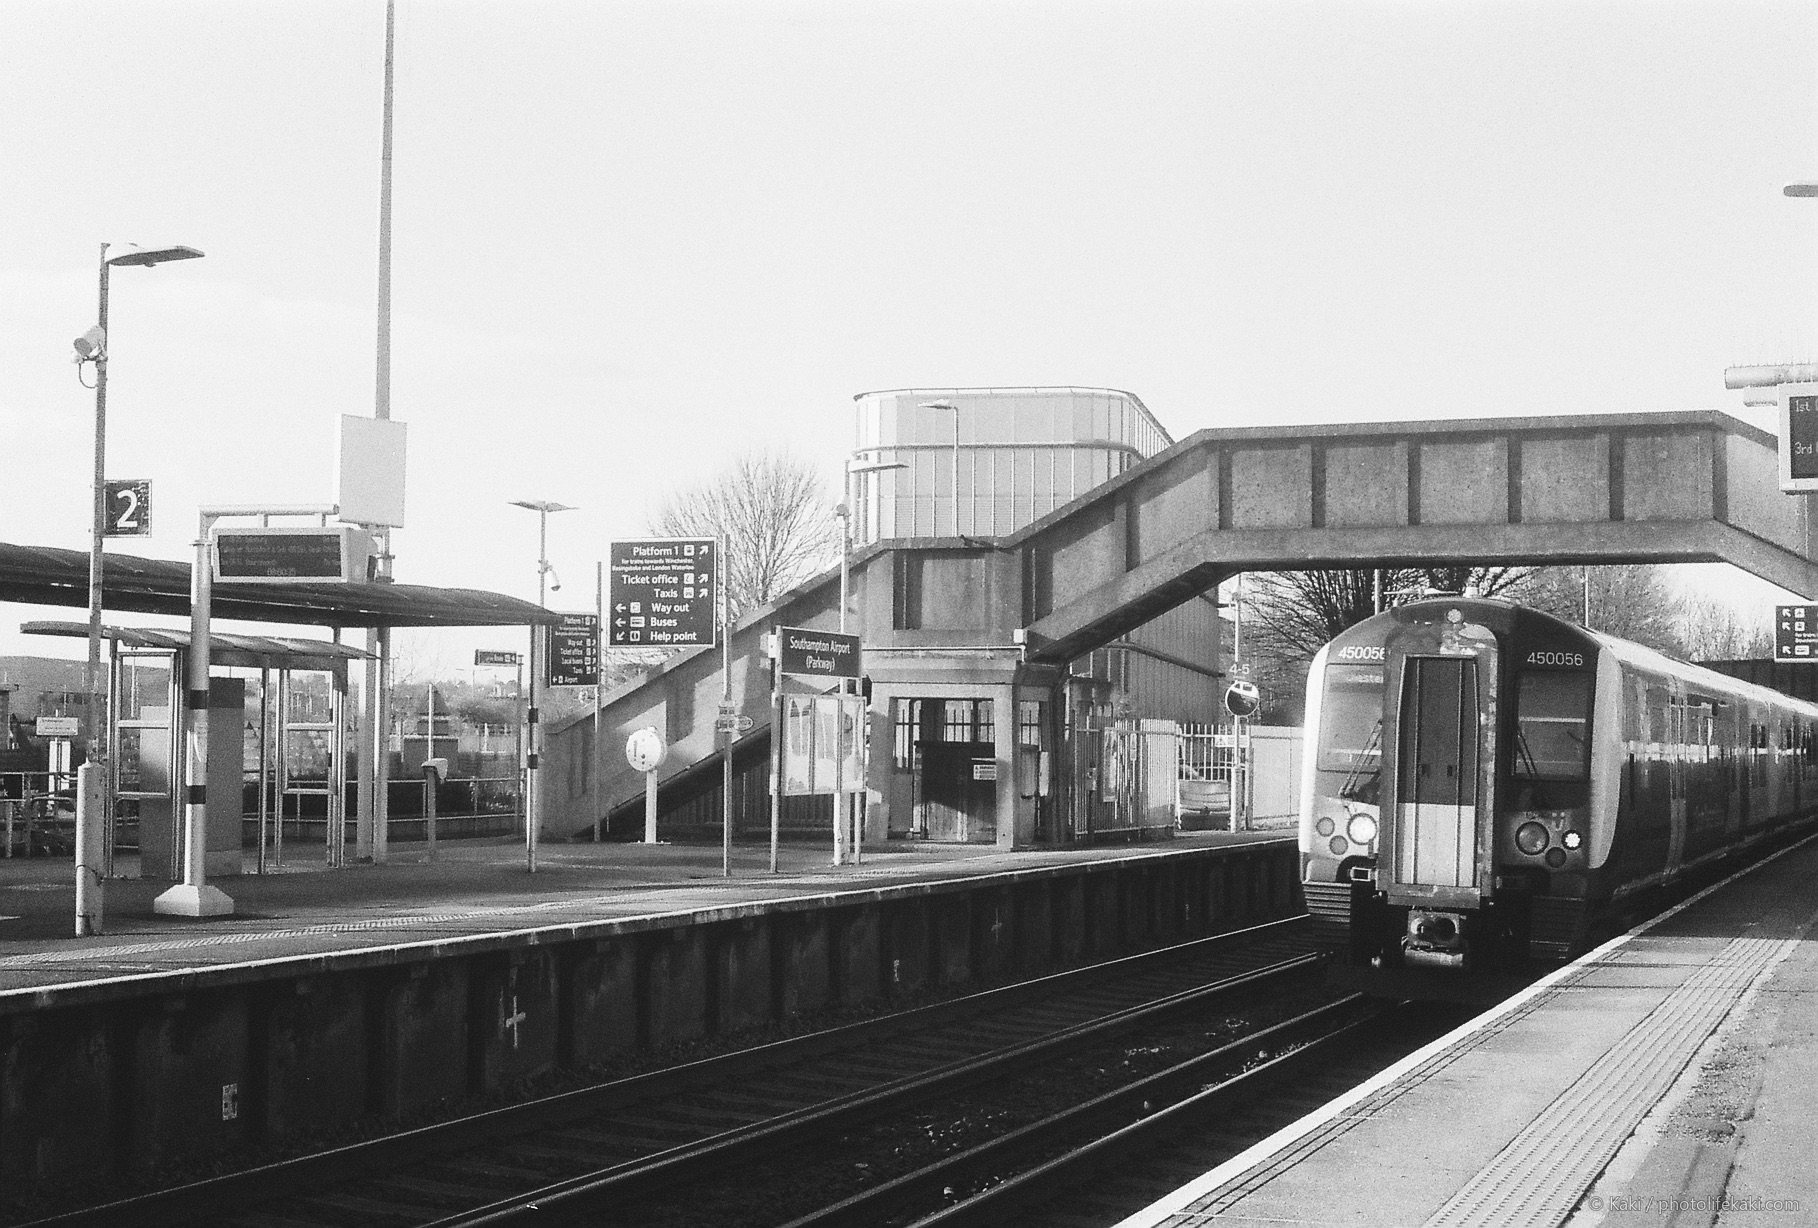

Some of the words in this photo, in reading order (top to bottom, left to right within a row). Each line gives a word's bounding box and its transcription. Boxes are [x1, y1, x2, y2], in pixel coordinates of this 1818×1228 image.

[1795, 400, 1810, 412] 1st
[1795, 441, 1813, 455] 3rd
[117, 489, 138, 528] 2
[633, 546, 673, 556] Platform
[674, 546, 679, 556] 1
[622, 574, 650, 585] Ticket
[651, 574, 679, 584] office
[654, 588, 678, 598] Taxis
[651, 603, 672, 614] Way
[673, 604, 690, 612] out
[650, 617, 678, 627] Buses
[650, 631, 671, 643] Help
[673, 631, 697, 643] point
[789, 635, 830, 654] Southampton
[830, 640, 851, 655] Airport
[806, 655, 836, 672] (Parkway)
[1527, 651, 1583, 666] 450056
[1229, 663, 1250, 676] 4-5
[565, 676, 578, 684] Airport
